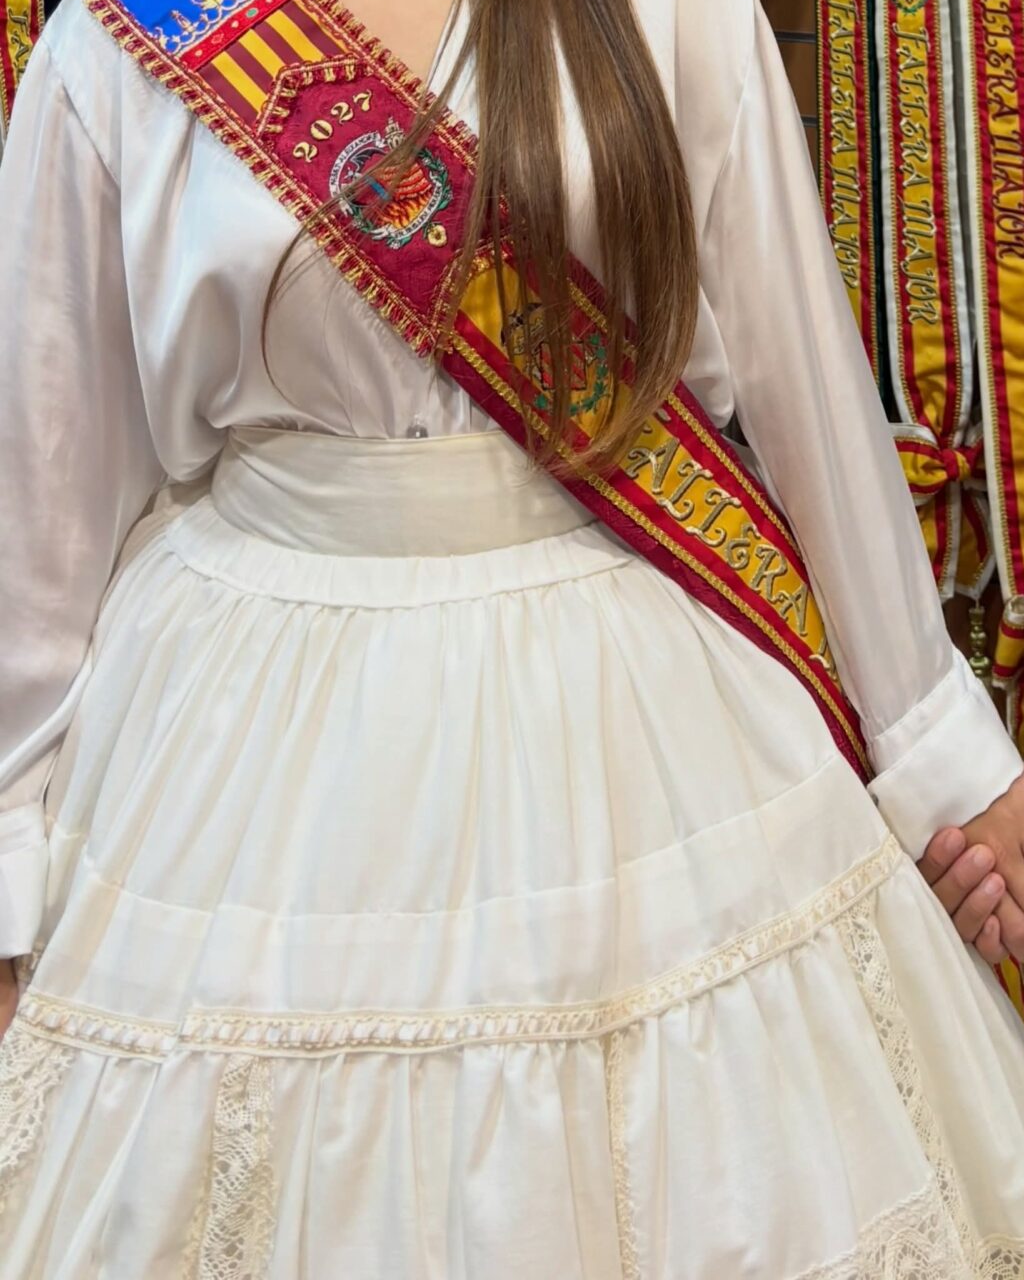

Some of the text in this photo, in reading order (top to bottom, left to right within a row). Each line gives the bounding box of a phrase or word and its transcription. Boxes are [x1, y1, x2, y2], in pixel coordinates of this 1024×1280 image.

[292, 89, 373, 163] 2027
[892, 22, 938, 326] FALLERA MAJOR
[626, 407, 809, 637] ALLERA
